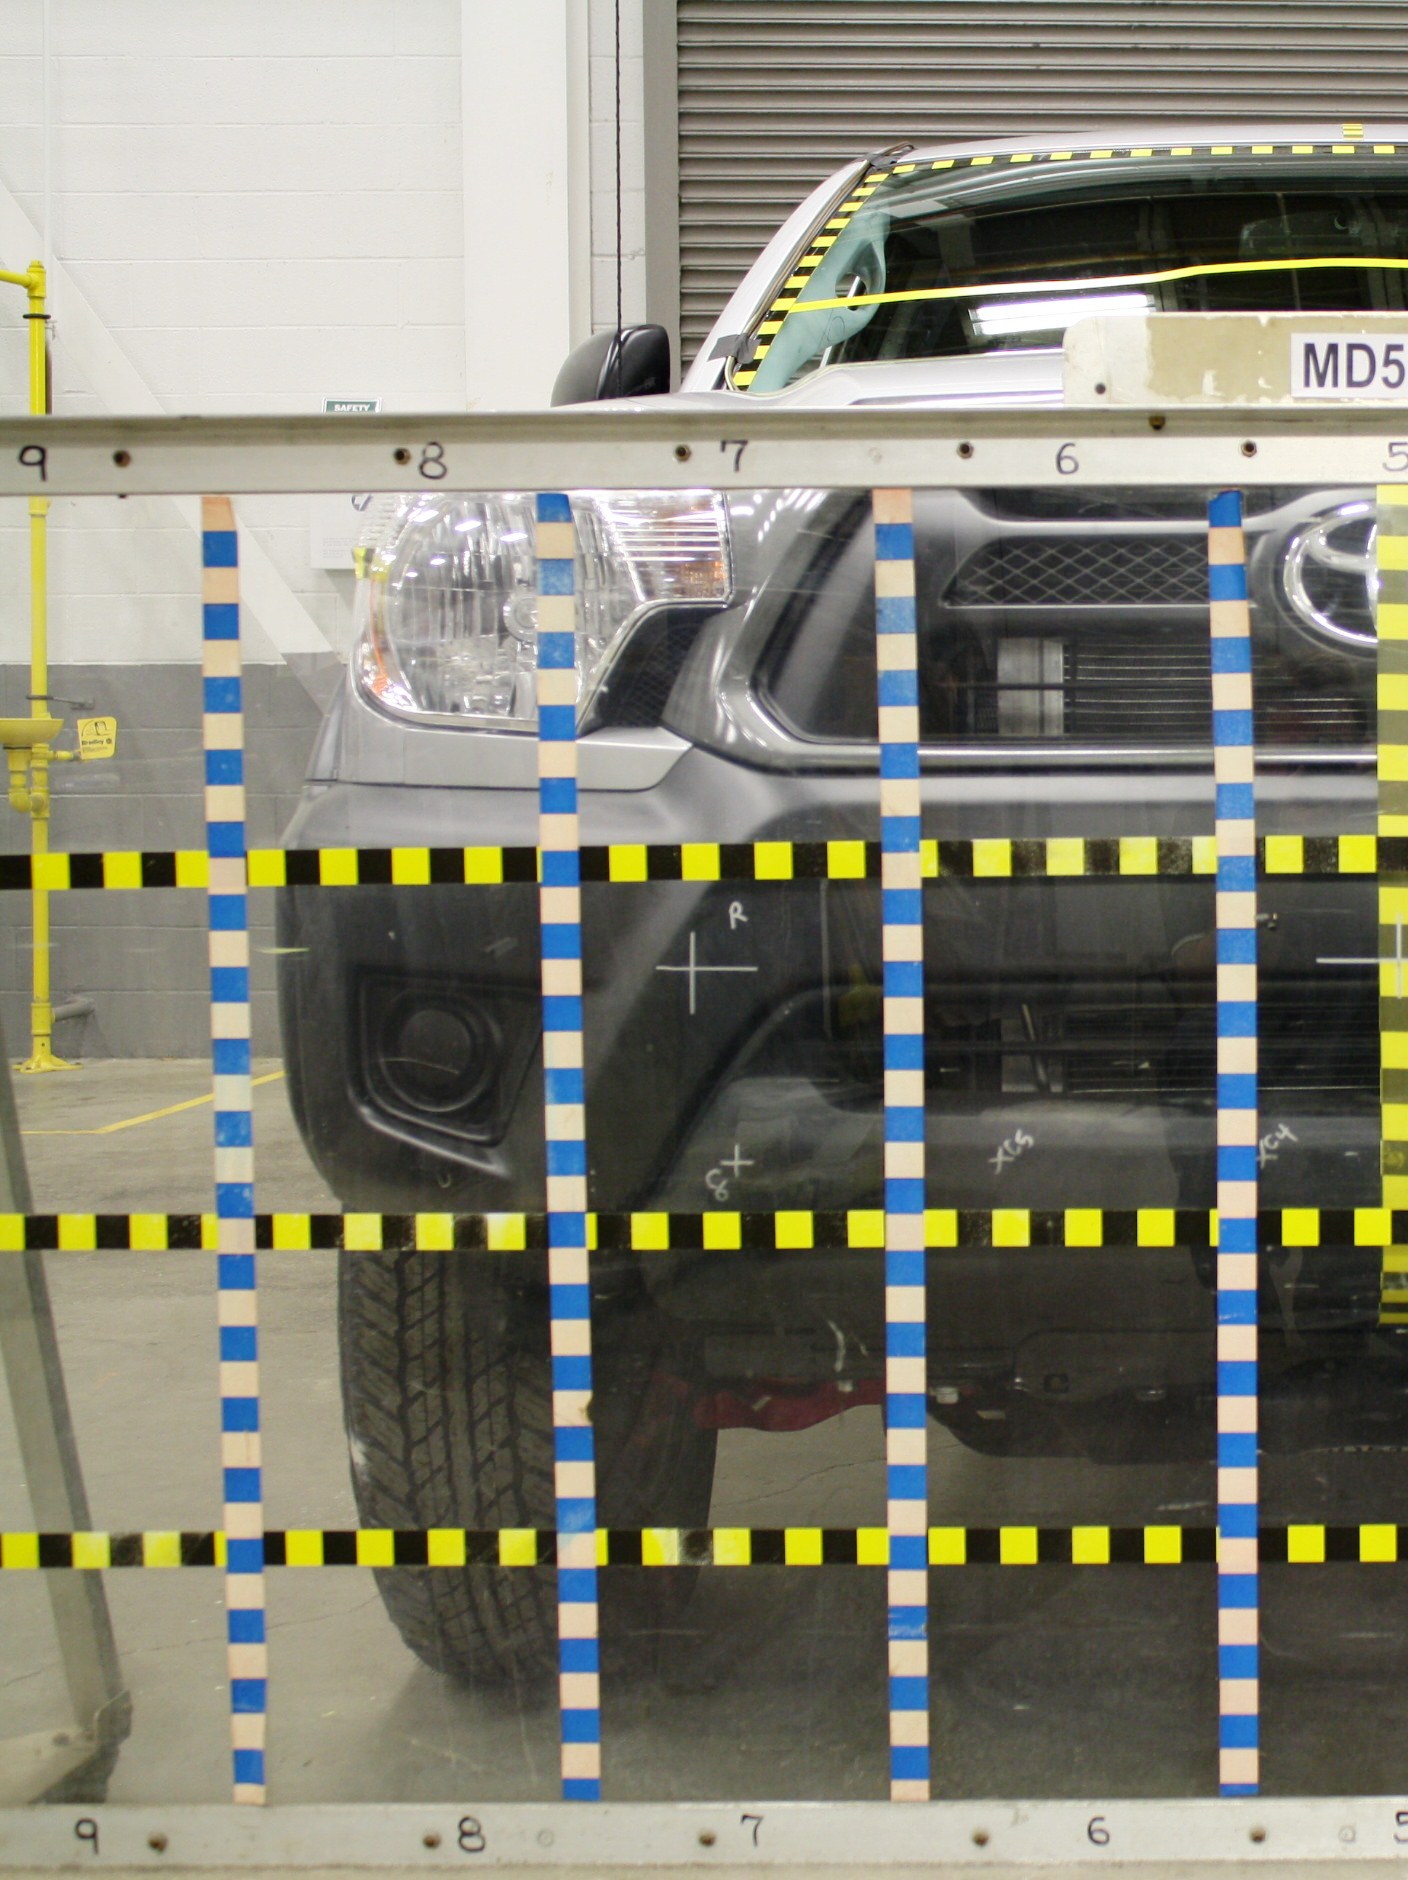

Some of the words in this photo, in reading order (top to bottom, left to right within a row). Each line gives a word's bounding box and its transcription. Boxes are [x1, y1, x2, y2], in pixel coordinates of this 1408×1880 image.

[334, 404, 370, 412] SAFETY
[18, 445, 47, 482] 9
[419, 441, 447, 480] 8
[720, 438, 749, 473] 7
[1055, 443, 1080, 475] 6
[728, 901, 749, 930] R
[75, 1818, 100, 1855] 9
[457, 1816, 486, 1853] 8
[740, 1814, 764, 1847] 7
[1086, 1816, 1111, 1846] 6
